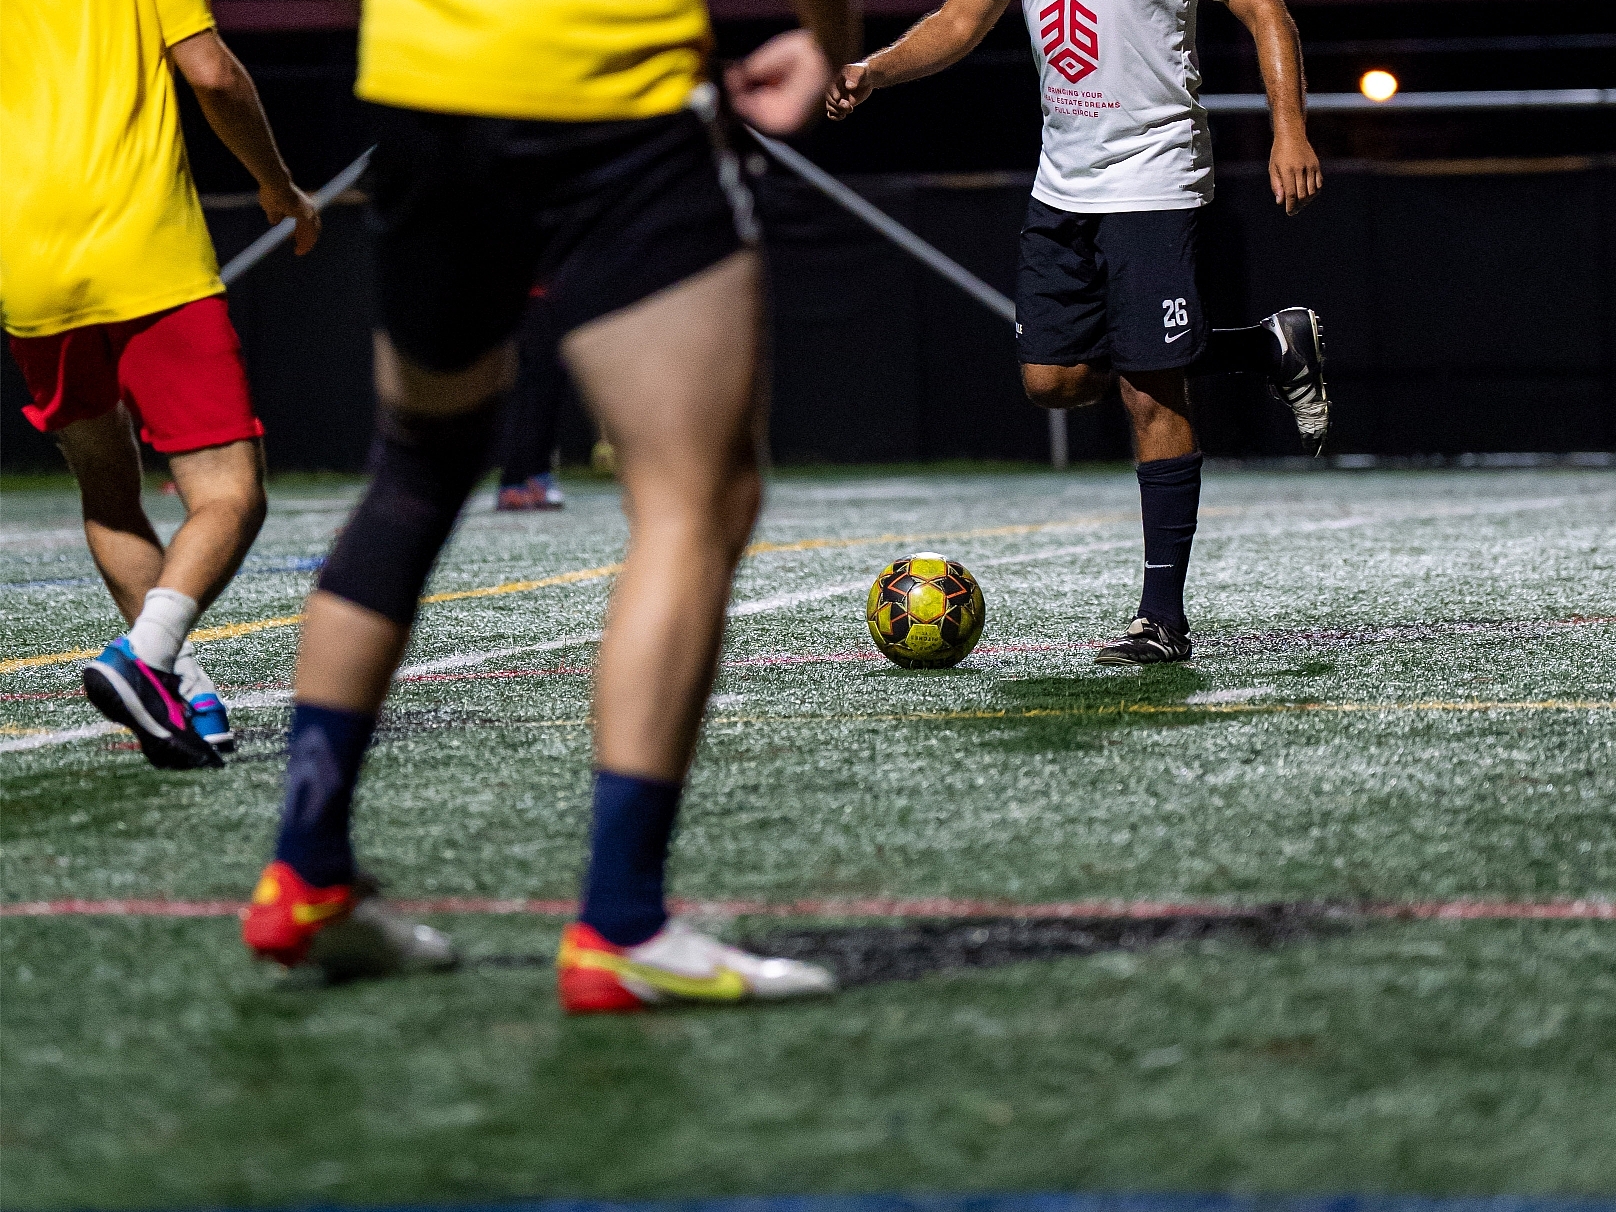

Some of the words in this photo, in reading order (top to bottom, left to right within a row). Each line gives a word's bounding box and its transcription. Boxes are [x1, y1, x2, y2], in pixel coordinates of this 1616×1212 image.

[1047, 86, 1079, 97] BRINGING
[1081, 90, 1103, 99] YOUR
[1056, 97, 1083, 107] ESTATE
[1084, 100, 1121, 109] DREAMS
[1054, 106, 1071, 115] FULL
[1072, 108, 1099, 118] CIRCLE
[1162, 298, 1188, 327] 26
